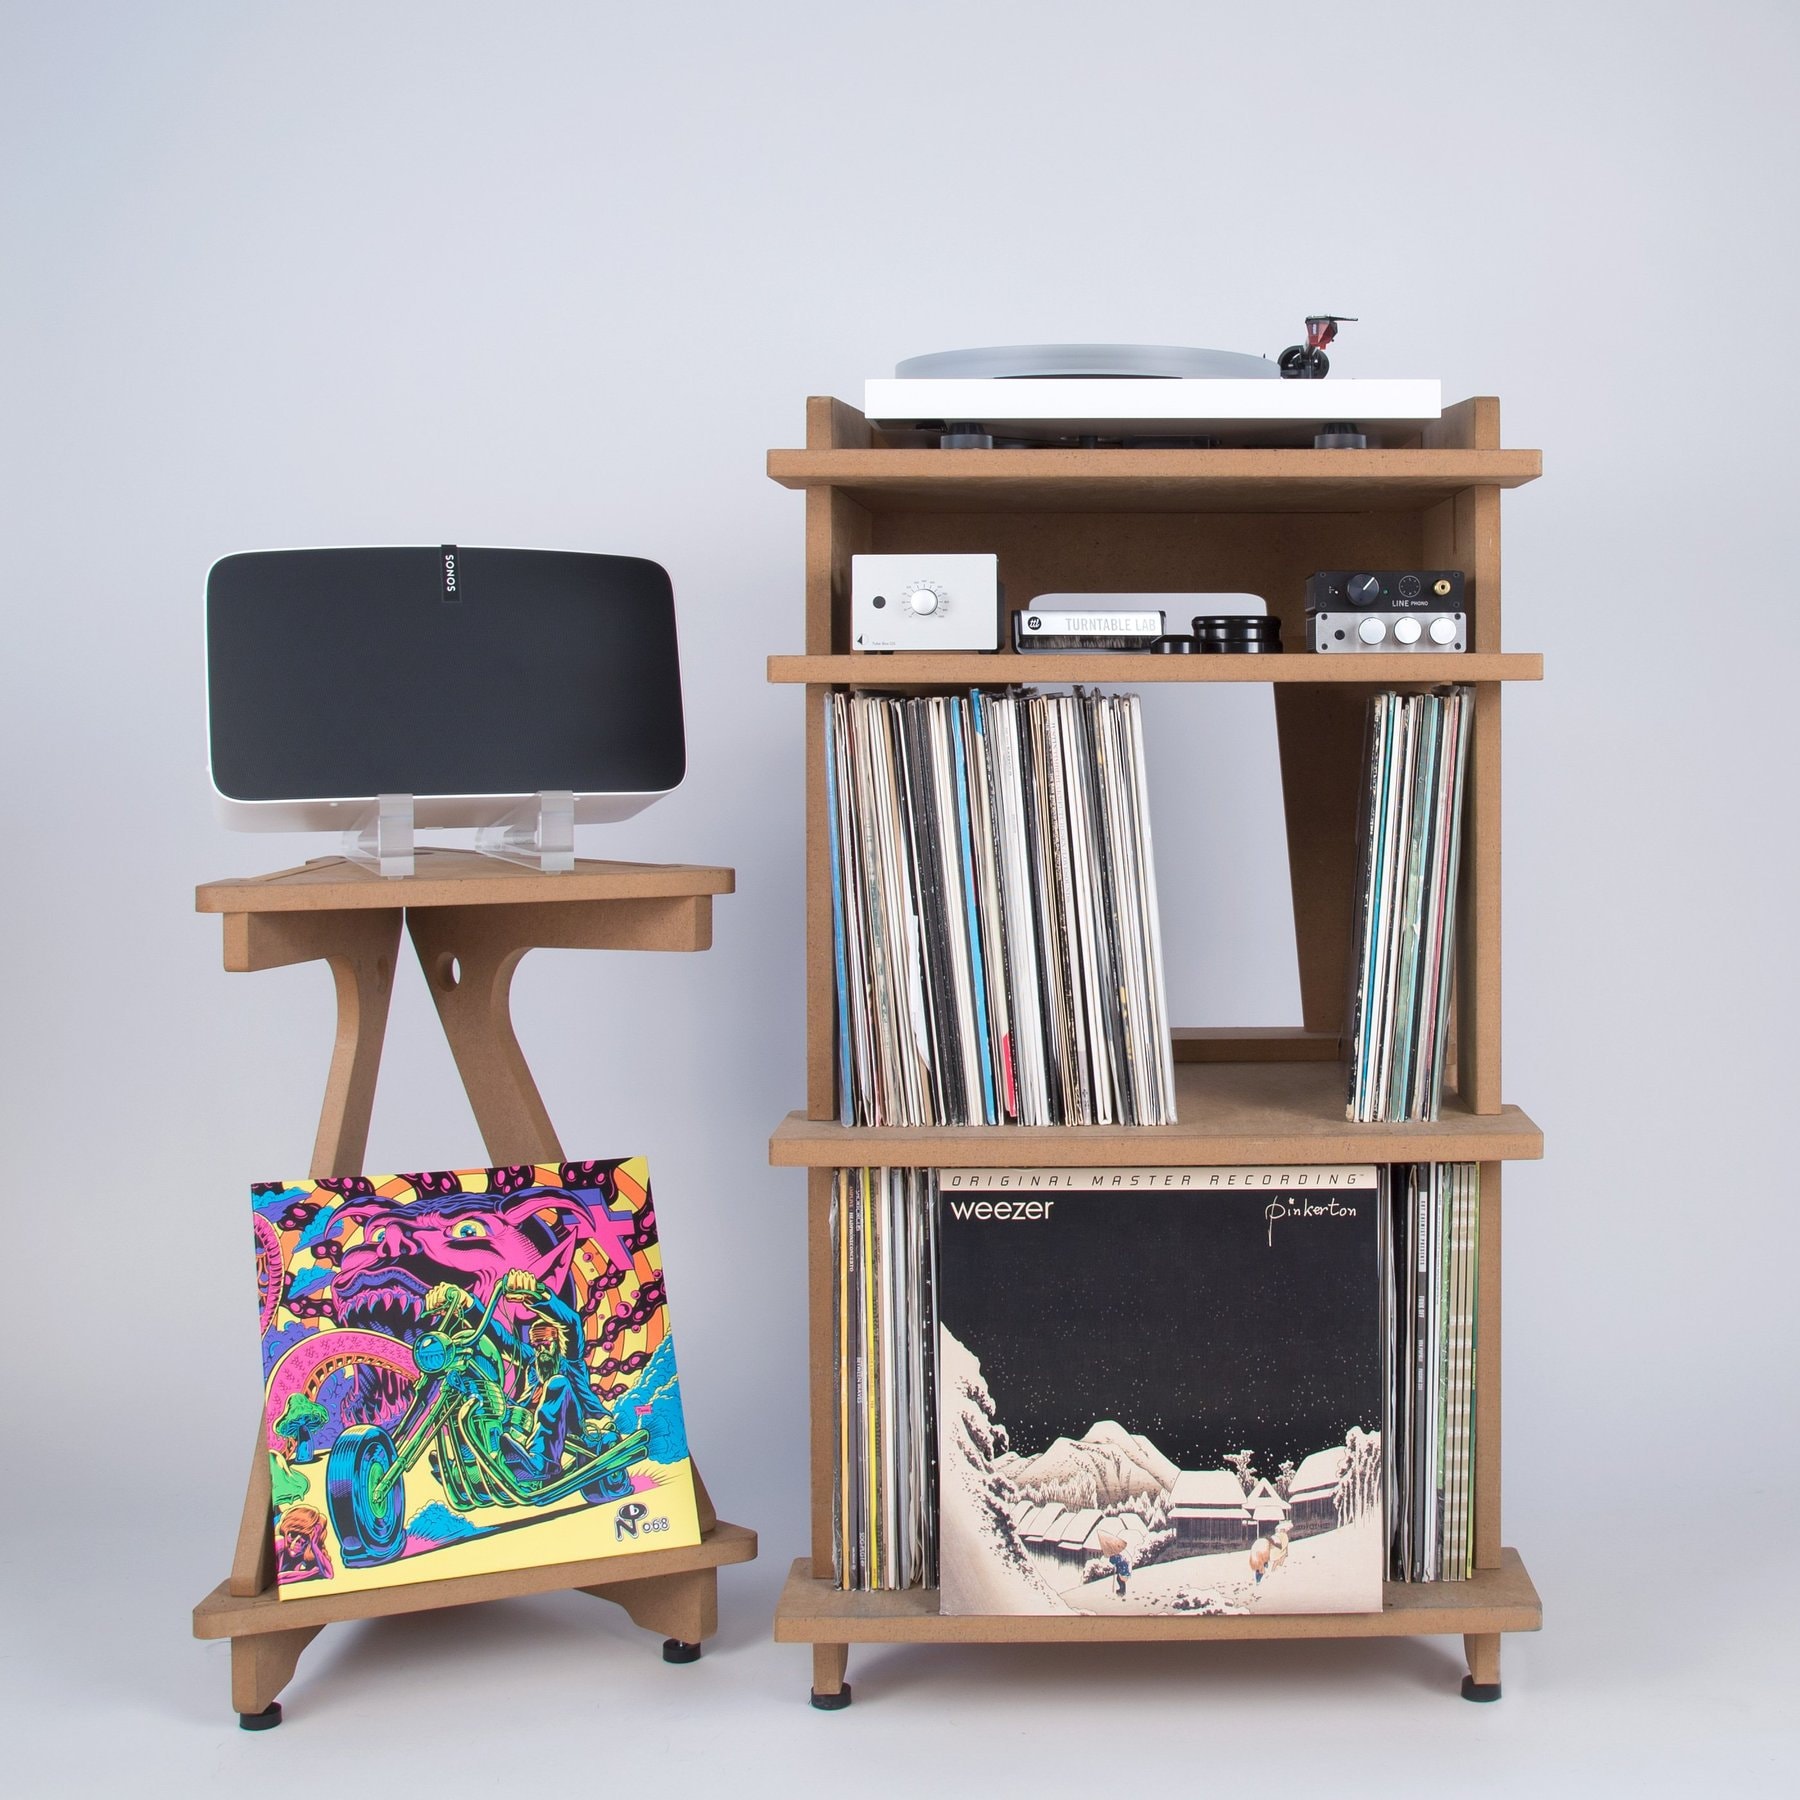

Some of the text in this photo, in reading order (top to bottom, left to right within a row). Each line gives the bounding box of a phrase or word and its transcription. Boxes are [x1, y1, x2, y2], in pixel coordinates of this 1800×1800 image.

[445, 554, 456, 592] SONOS
[1065, 618, 1156, 632] TURNTABLE LAB
[951, 1175, 1073, 1187] ORIGINAL
[1091, 1174, 1191, 1186] MASTER
[950, 1201, 1055, 1220] weezer
[1265, 1195, 1357, 1247] pinkerton
